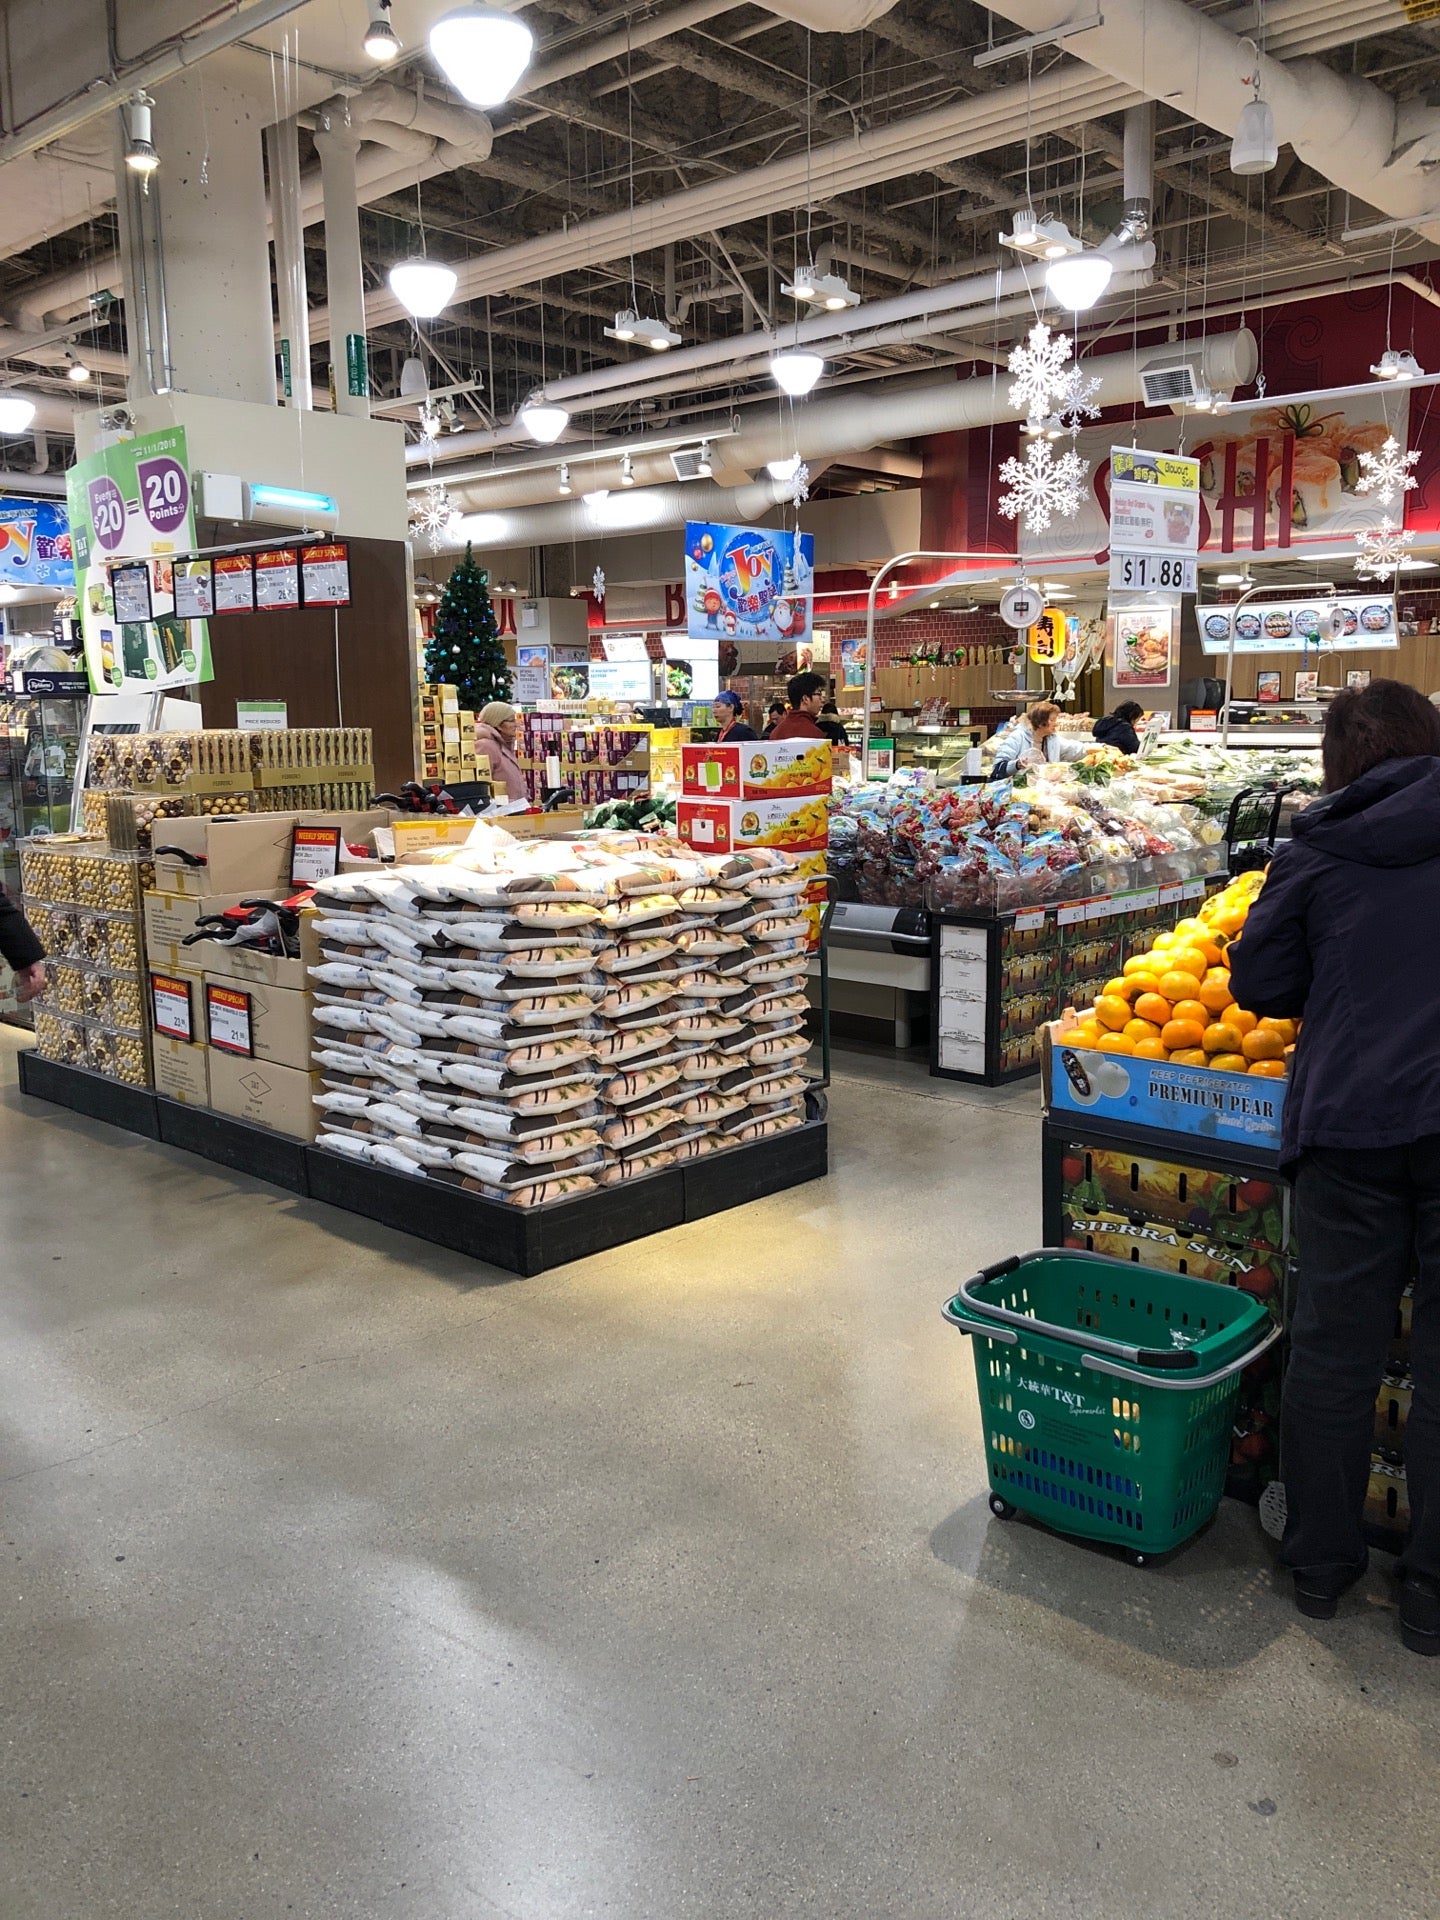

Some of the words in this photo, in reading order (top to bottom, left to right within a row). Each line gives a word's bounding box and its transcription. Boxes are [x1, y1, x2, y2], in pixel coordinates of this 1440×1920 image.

[1165, 462, 1189, 476] Blowout
[146, 470, 181, 509] 20
[1182, 477, 1194, 488] Sale
[94, 490, 112, 504] Every
[94, 500, 122, 536] $20
[149, 505, 178, 521] Points
[1124, 559, 1183, 587] $1.88
[774, 754, 796, 763] KOREAN
[298, 832, 316, 840] WEEKLY
[316, 832, 335, 841] SPECIAL
[1068, 943, 1099, 958] SIERRA
[1098, 941, 1115, 949] SUN
[1003, 957, 1035, 972] SIERRA
[1035, 954, 1054, 964] SUN
[155, 978, 170, 989] WEEKLY
[171, 982, 187, 993] SPECIAL
[1067, 981, 1098, 996] SIERRA
[212, 989, 227, 1000] WEEKLY
[228, 994, 245, 1006] SPECIAL
[1002, 998, 1034, 1014] SIERRA
[1033, 995, 1052, 1004] SUN
[1150, 1069, 1176, 1080] KEEP
[1178, 1073, 1251, 1094] REFRIGERATED
[1149, 1081, 1224, 1110] PREMIUM
[1229, 1095, 1274, 1118] PEAR
[1062, 1192, 1115, 1209] REMIUM
[1123, 1206, 1213, 1232] CALIFORNIA
[1222, 1229, 1266, 1244] FRUIT
[1071, 1219, 1180, 1247] SIERRA
[1186, 1240, 1255, 1275] SUN
[1051, 1386, 1086, 1408] T&T
[1069, 1404, 1106, 1416] Supermarket
